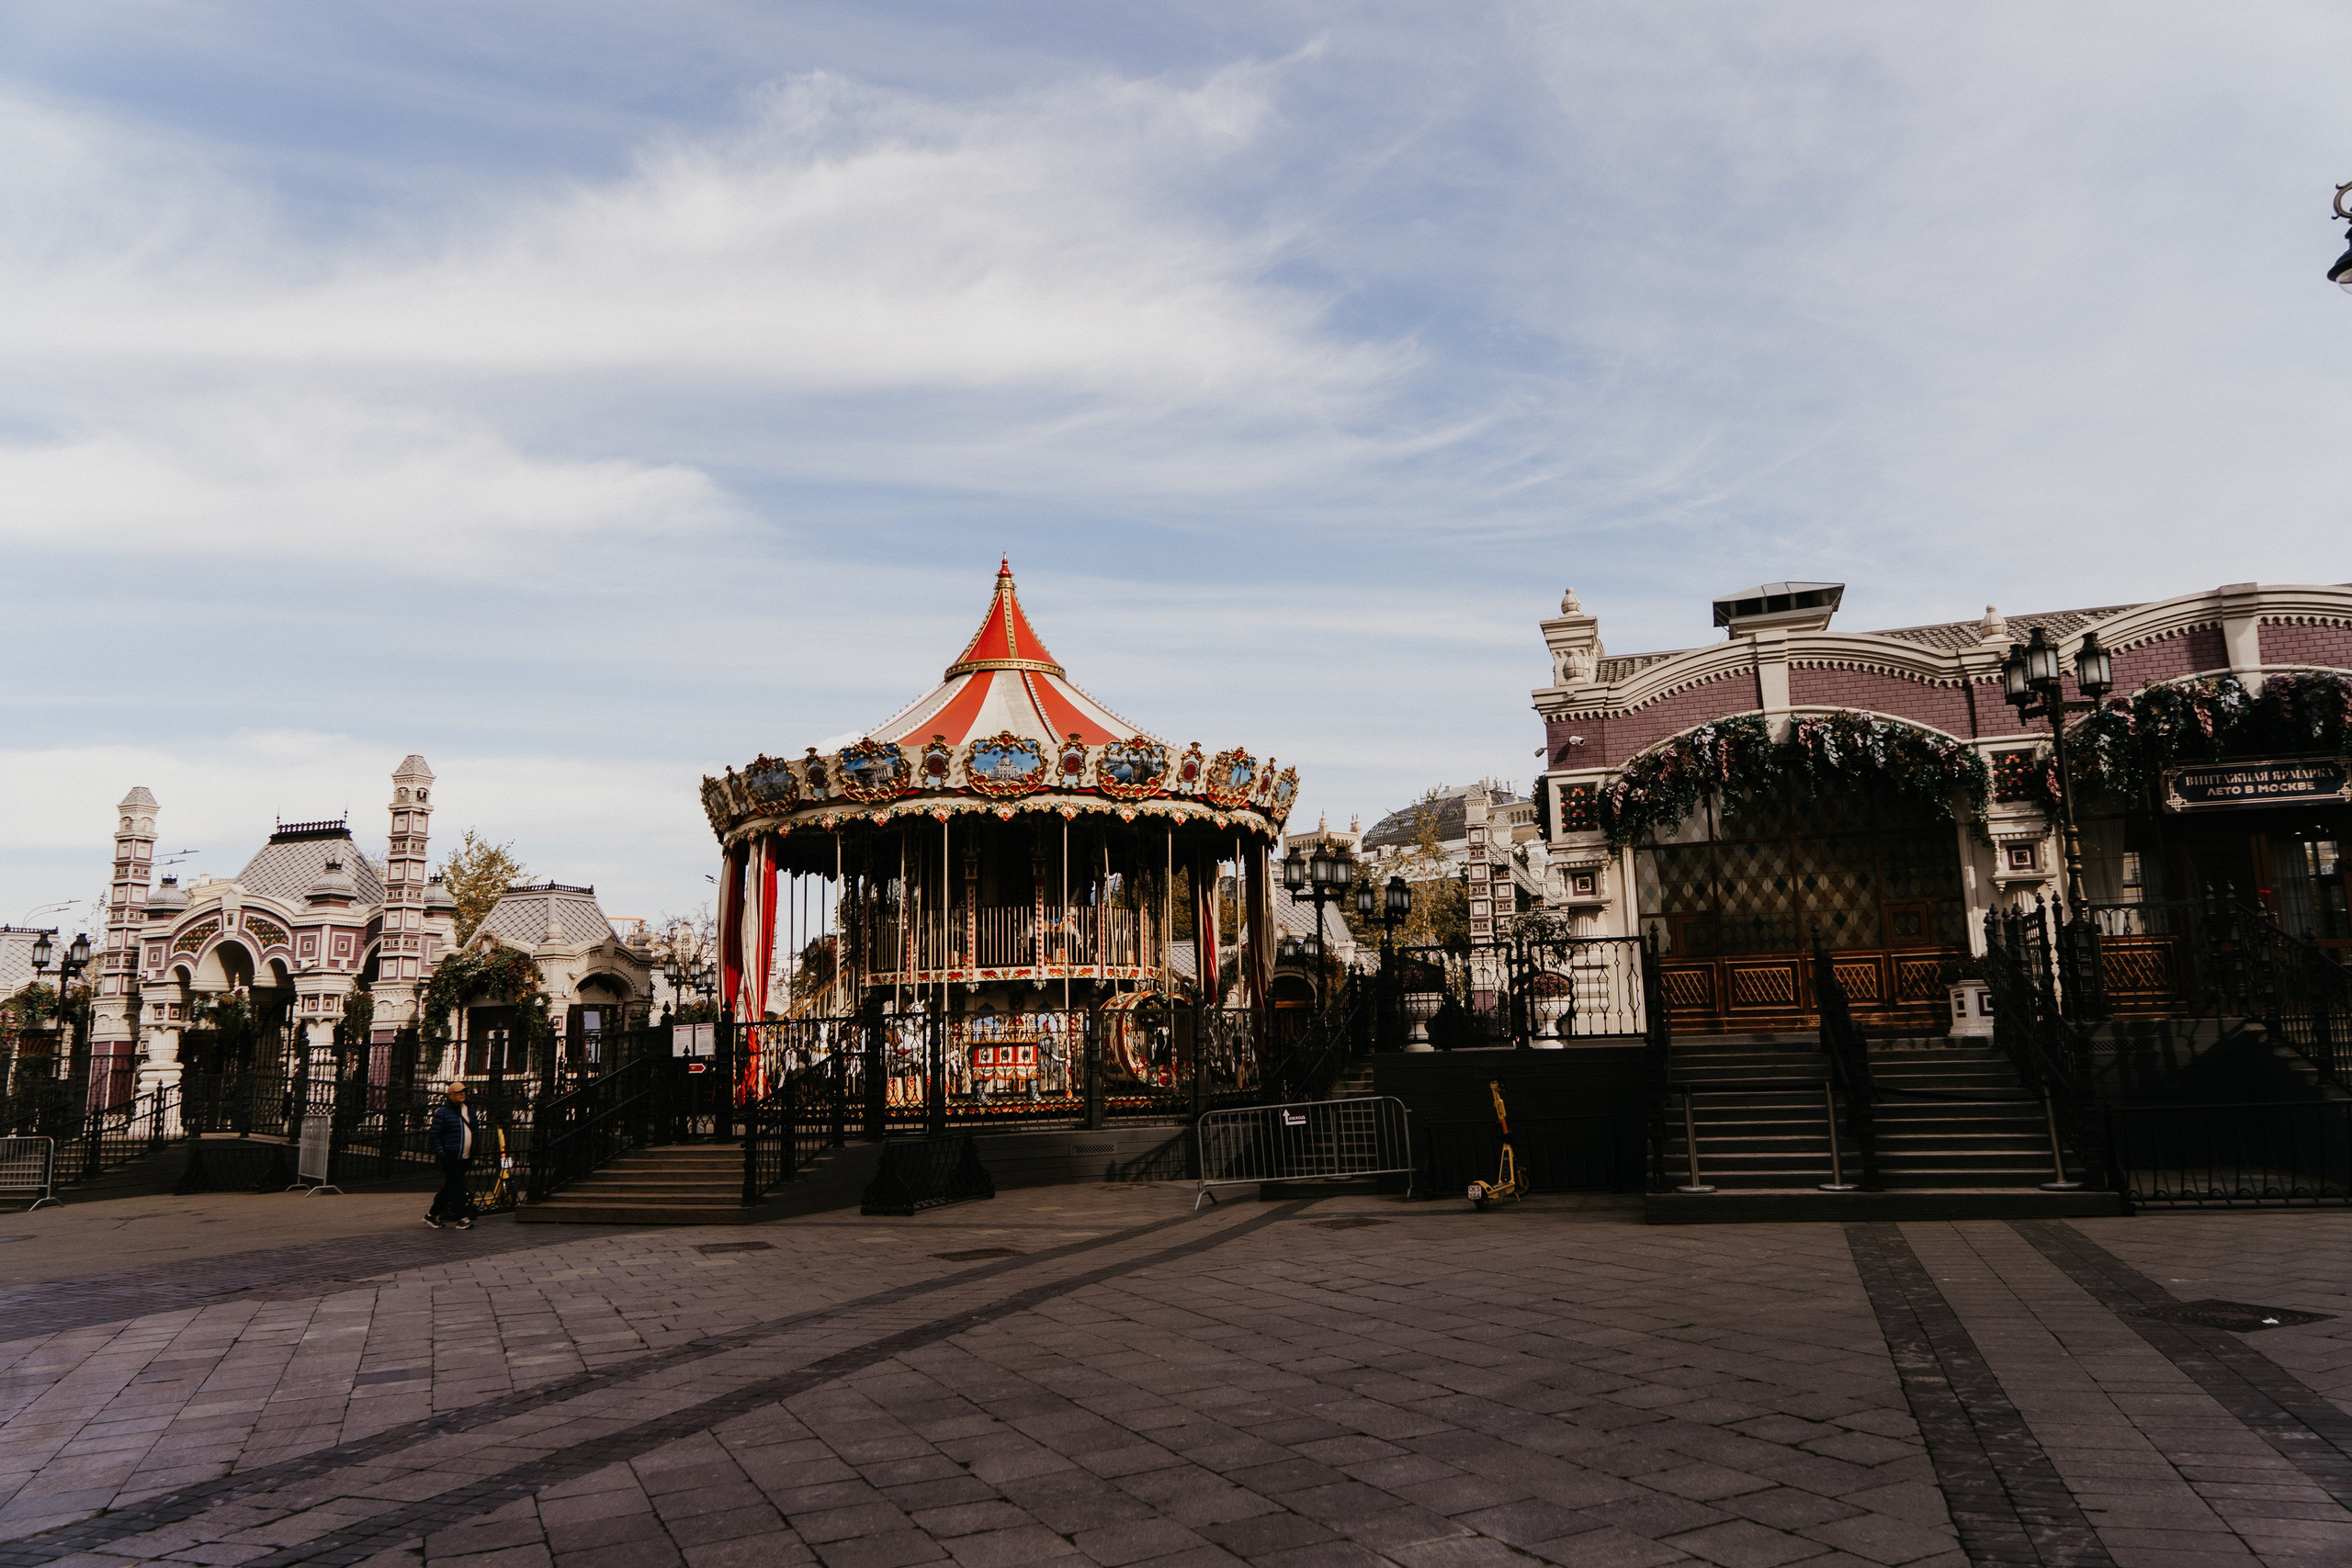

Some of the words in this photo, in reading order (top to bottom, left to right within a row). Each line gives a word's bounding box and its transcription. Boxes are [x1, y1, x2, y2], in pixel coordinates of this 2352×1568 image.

[2185, 771, 2268, 786] ВИНТАЖНАЯ
[2272, 768, 2335, 781] ЯРМАРКА
[2207, 785, 2242, 796] ЛЕТО
[2245, 784, 2256, 794] В
[2257, 782, 2316, 794] МОСКВЕ
